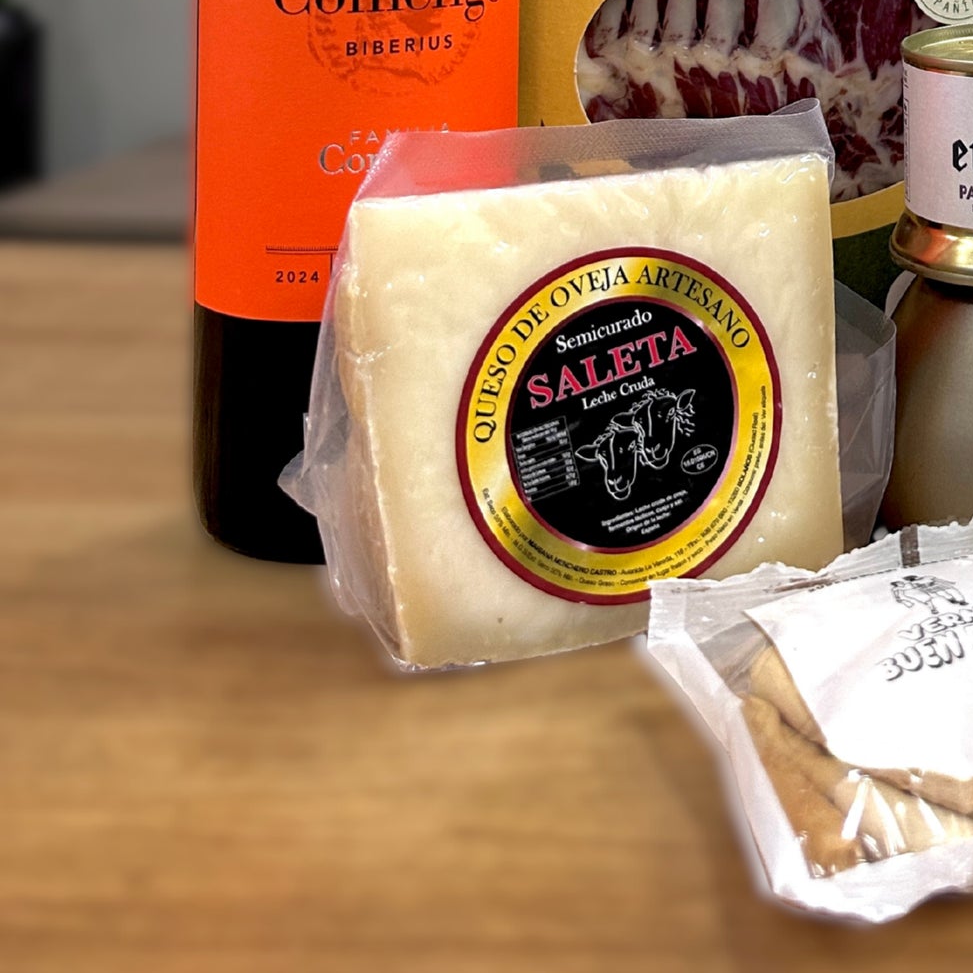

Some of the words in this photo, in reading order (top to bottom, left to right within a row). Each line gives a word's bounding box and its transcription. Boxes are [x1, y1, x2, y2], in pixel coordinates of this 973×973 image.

[345, 34, 453, 57] BIBERIUS
[275, 270, 320, 284] 2024
[473, 343, 517, 444] QUESO
[511, 302, 550, 343] DE
[550, 264, 630, 308] OVEJA
[636, 264, 751, 349] ARTESANO
[555, 308, 653, 354] Semicurado
[526, 325, 698, 409] SALETA
[581, 388, 618, 411] Leche
[619, 376, 656, 397] Cruda
[875, 629, 965, 682] BUEN
